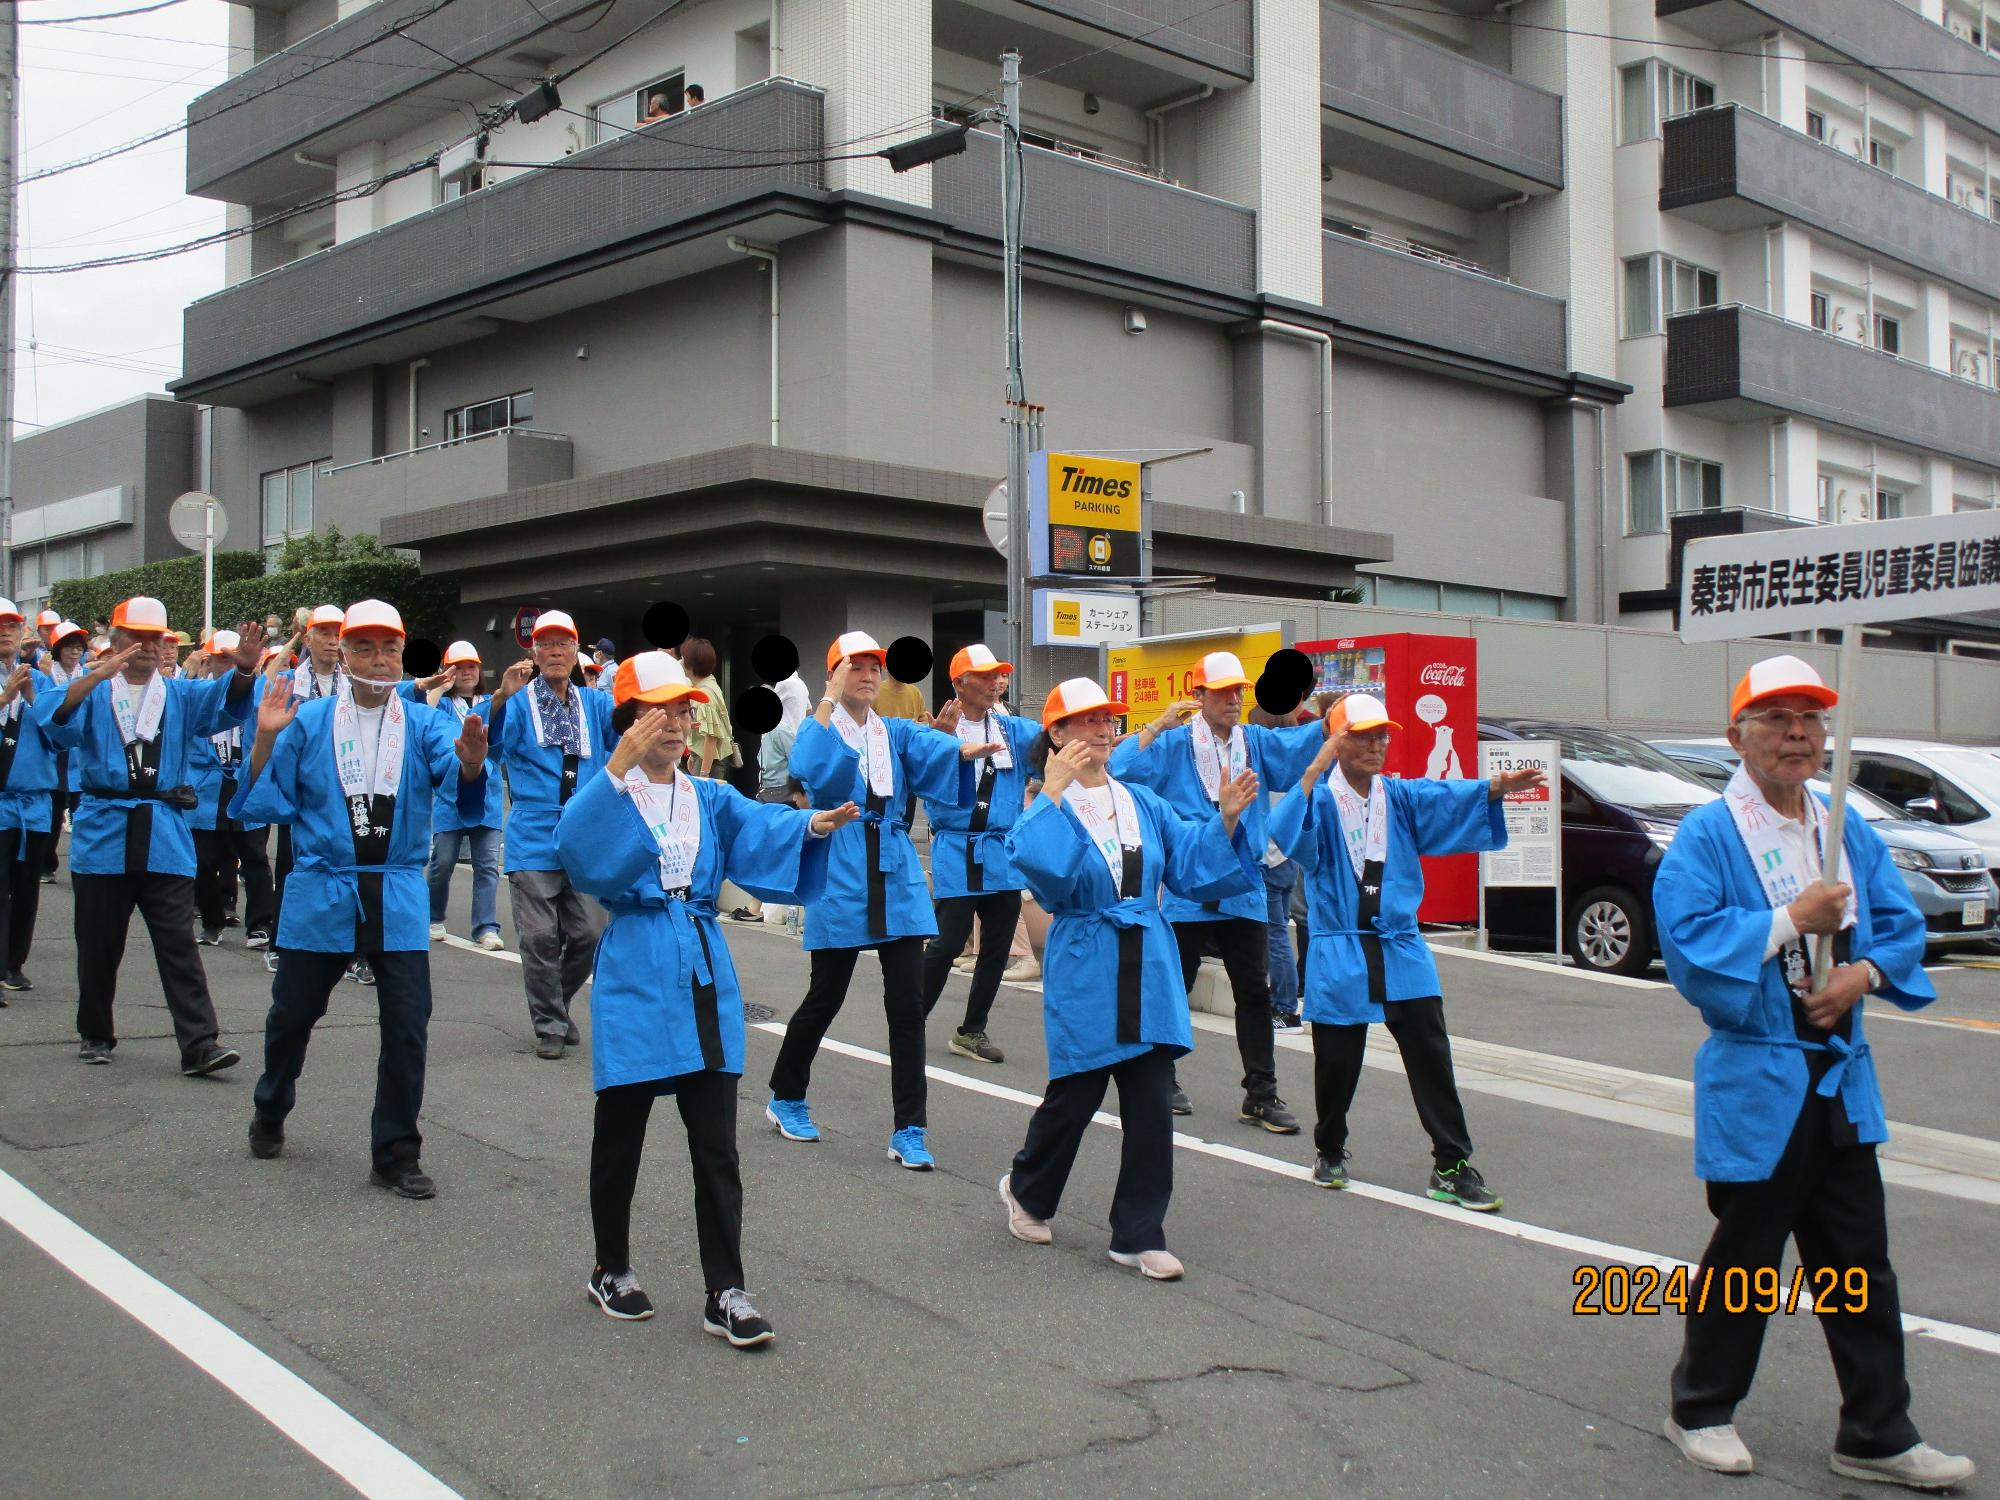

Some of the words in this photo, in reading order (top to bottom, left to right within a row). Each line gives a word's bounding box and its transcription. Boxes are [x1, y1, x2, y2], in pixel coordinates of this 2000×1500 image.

[1061, 466, 1132, 498] Times
[1074, 501, 1120, 514] PARKING
[1056, 611, 1078, 621] Times
[1089, 608, 1129, 620] カーシェア
[1086, 620, 1133, 632] ステーション
[1421, 664, 1468, 687] Coca-Cola
[1134, 676, 1156, 690] 駐車後
[1134, 690, 1159, 703] 24時間
[341, 739, 355, 758] JT
[1349, 828, 1363, 845] JT
[1761, 848, 1784, 874] JT
